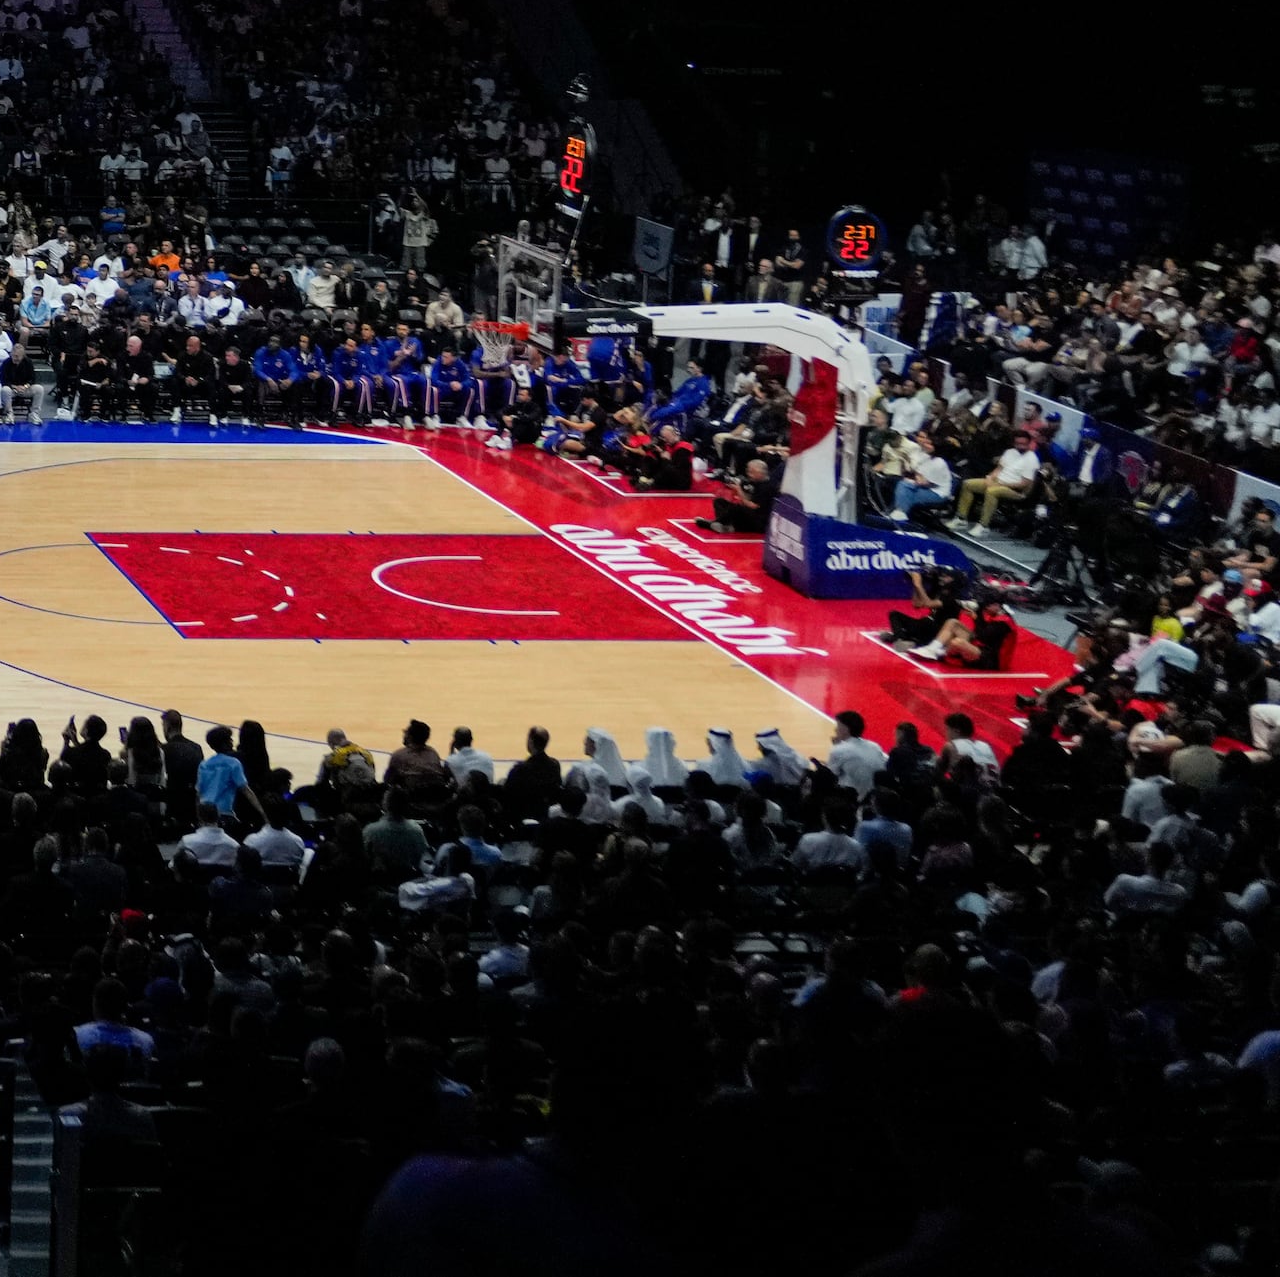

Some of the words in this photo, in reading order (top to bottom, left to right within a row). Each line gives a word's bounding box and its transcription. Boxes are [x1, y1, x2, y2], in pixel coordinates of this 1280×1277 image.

[840, 240, 870, 260] 22
[548, 524, 672, 572] abu
[825, 550, 870, 571] abu
